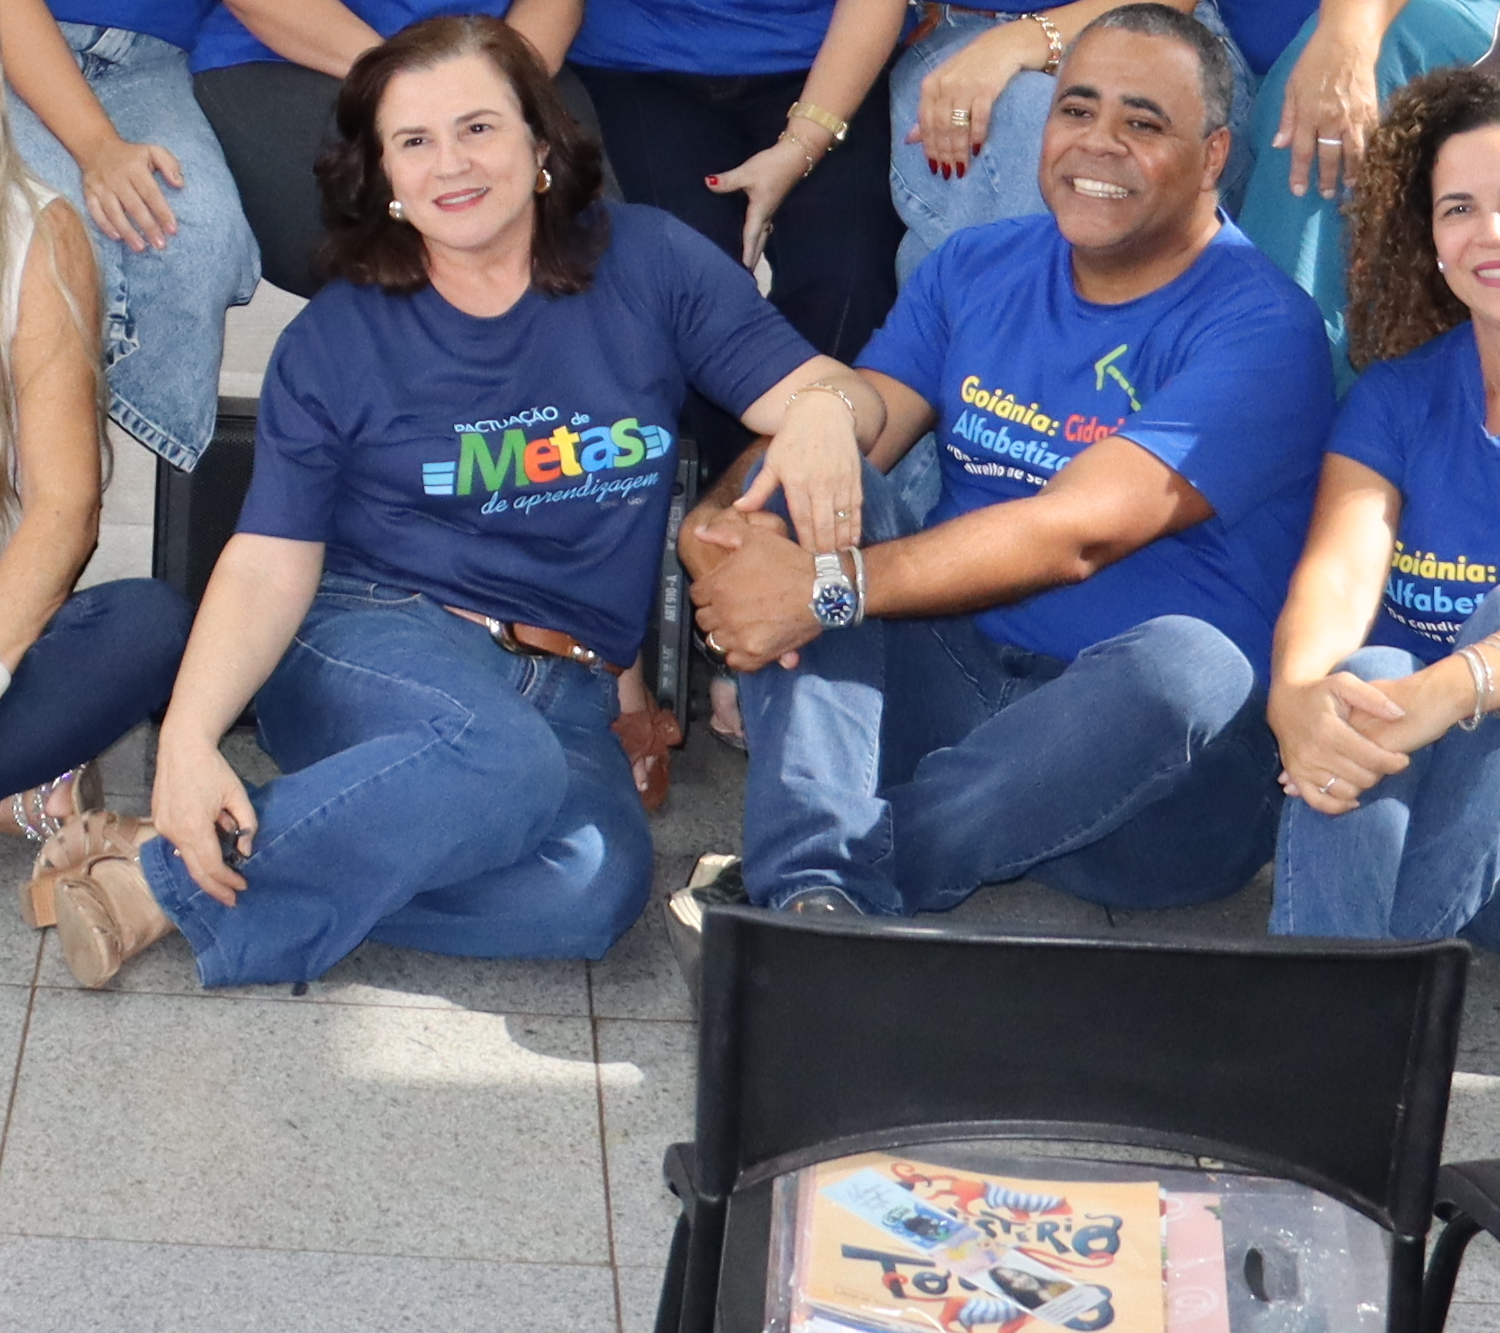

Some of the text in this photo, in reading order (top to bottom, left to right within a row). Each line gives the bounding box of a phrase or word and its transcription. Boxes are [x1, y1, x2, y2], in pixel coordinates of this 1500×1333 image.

[453, 405, 591, 434] PACTUAÇÃO de
[960, 375, 1060, 437] Goiânia:
[456, 417, 646, 496] Metas
[480, 469, 660, 516] de aprendizagem
